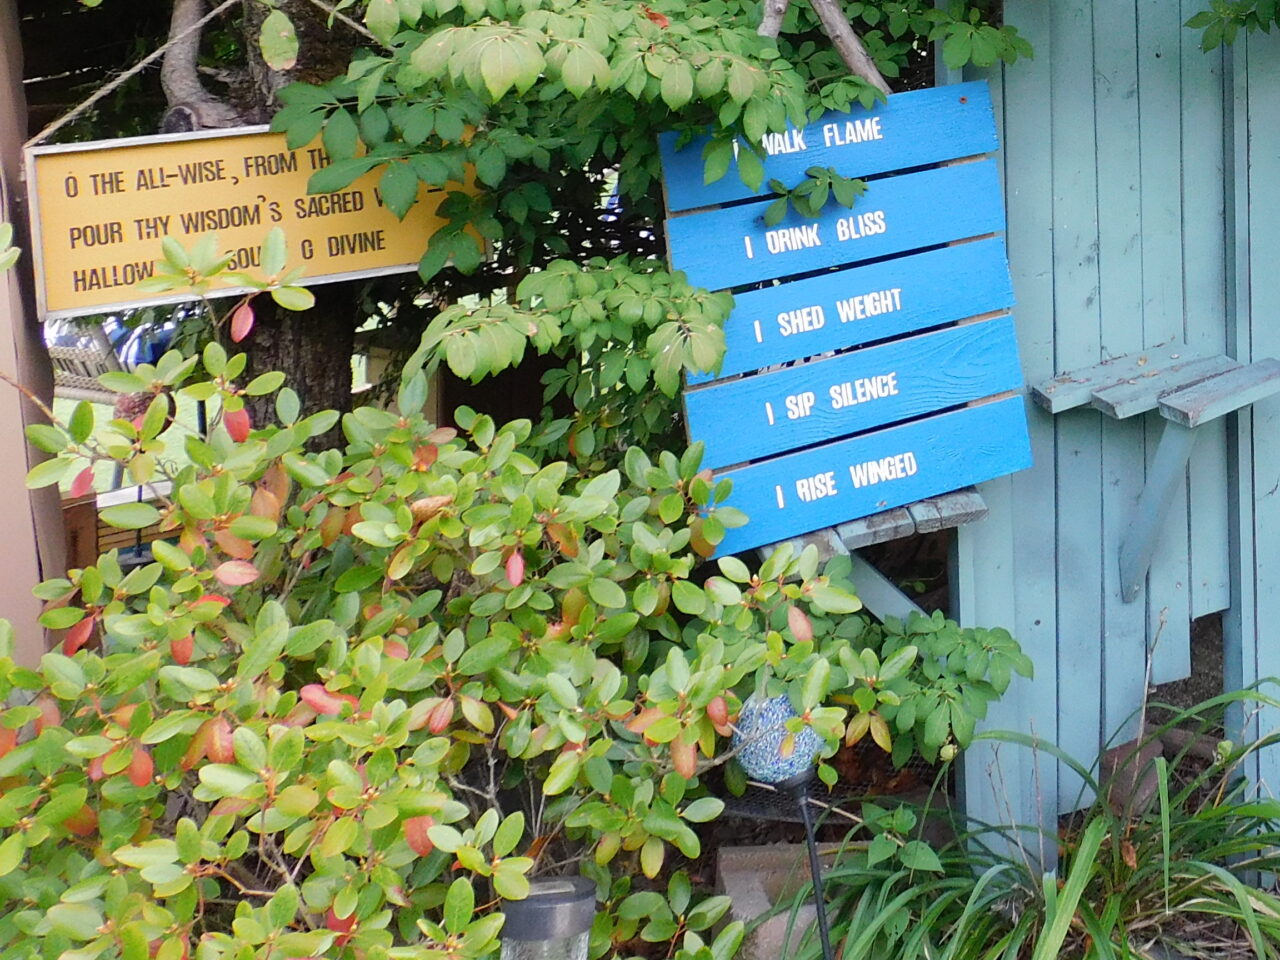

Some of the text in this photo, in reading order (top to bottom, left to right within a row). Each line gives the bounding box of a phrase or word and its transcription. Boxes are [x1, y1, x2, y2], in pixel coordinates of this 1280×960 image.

[823, 116, 883, 147] FLAME
[64, 175, 79, 198] O
[89, 171, 126, 196] THE
[244, 150, 298, 178] FROM
[307, 148, 332, 170] TH
[69, 221, 123, 249] POUR
[133, 215, 170, 240] THY
[295, 191, 364, 219] SACRED
[744, 210, 887, 259] I DRINK BLISS
[222, 245, 262, 271] SOU
[327, 228, 387, 258] DIVINE
[753, 288, 902, 343] I SHED WEIGHT
[765, 371, 899, 425] I SIP SILENCE
[775, 451, 918, 509] I RISE WINGED
